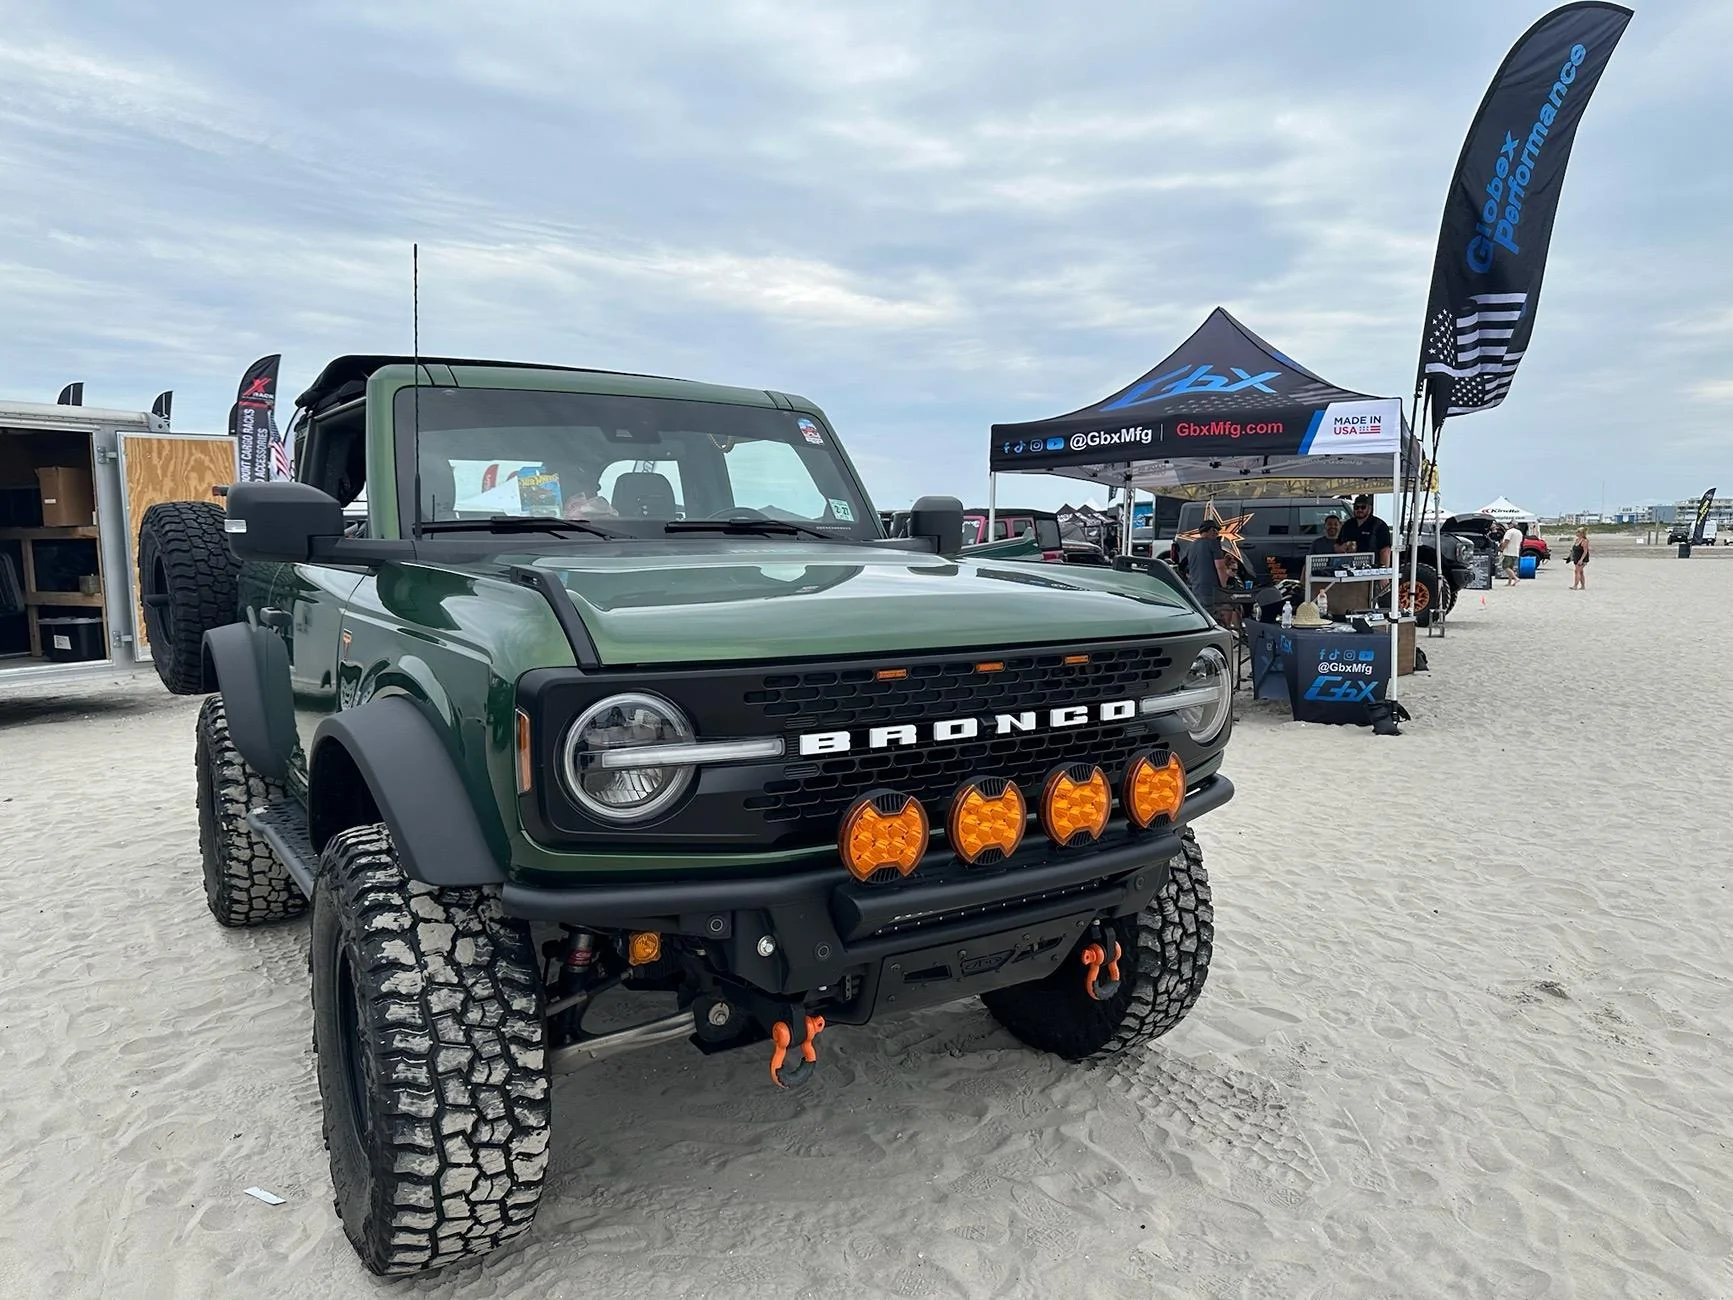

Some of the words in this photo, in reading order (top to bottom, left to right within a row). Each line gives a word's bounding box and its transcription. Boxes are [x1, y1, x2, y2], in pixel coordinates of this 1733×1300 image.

[1493, 43, 1587, 256] Performance
[1466, 129, 1520, 275] Globex
[242, 408, 255, 434] RACKS
[1334, 416, 1367, 426] MADE
[1371, 415, 1382, 425] IN
[1334, 426, 1358, 436] USA
[241, 434, 253, 460] CARGO
[1069, 427, 1153, 452] @GbxMfg
[1176, 420, 1284, 440] GbxMfg.com
[255, 427, 268, 478] ACCESSORIES
[1318, 661, 1373, 675] @GbxMfg
[799, 699, 1136, 756] BRONCO
